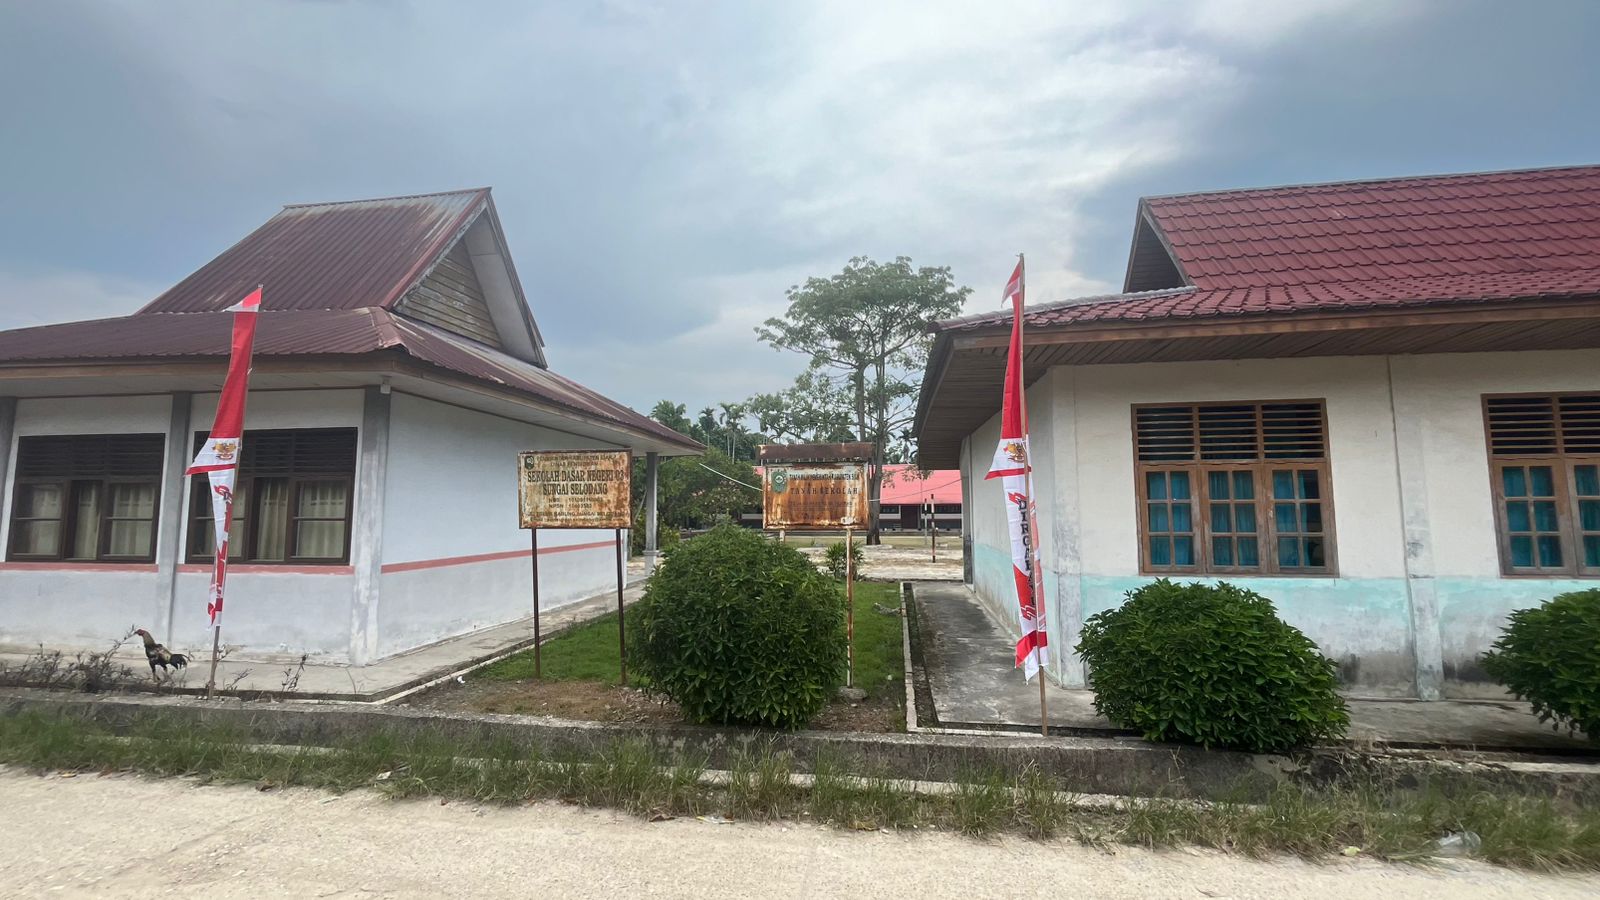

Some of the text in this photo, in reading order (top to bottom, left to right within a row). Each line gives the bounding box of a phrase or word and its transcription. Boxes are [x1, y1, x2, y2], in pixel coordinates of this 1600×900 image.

[528, 471, 560, 482] SEKOLAH
[562, 470, 585, 482] DASAR
[587, 470, 613, 481] NEGERI
[543, 483, 608, 495] SUNGAI SELODANG
